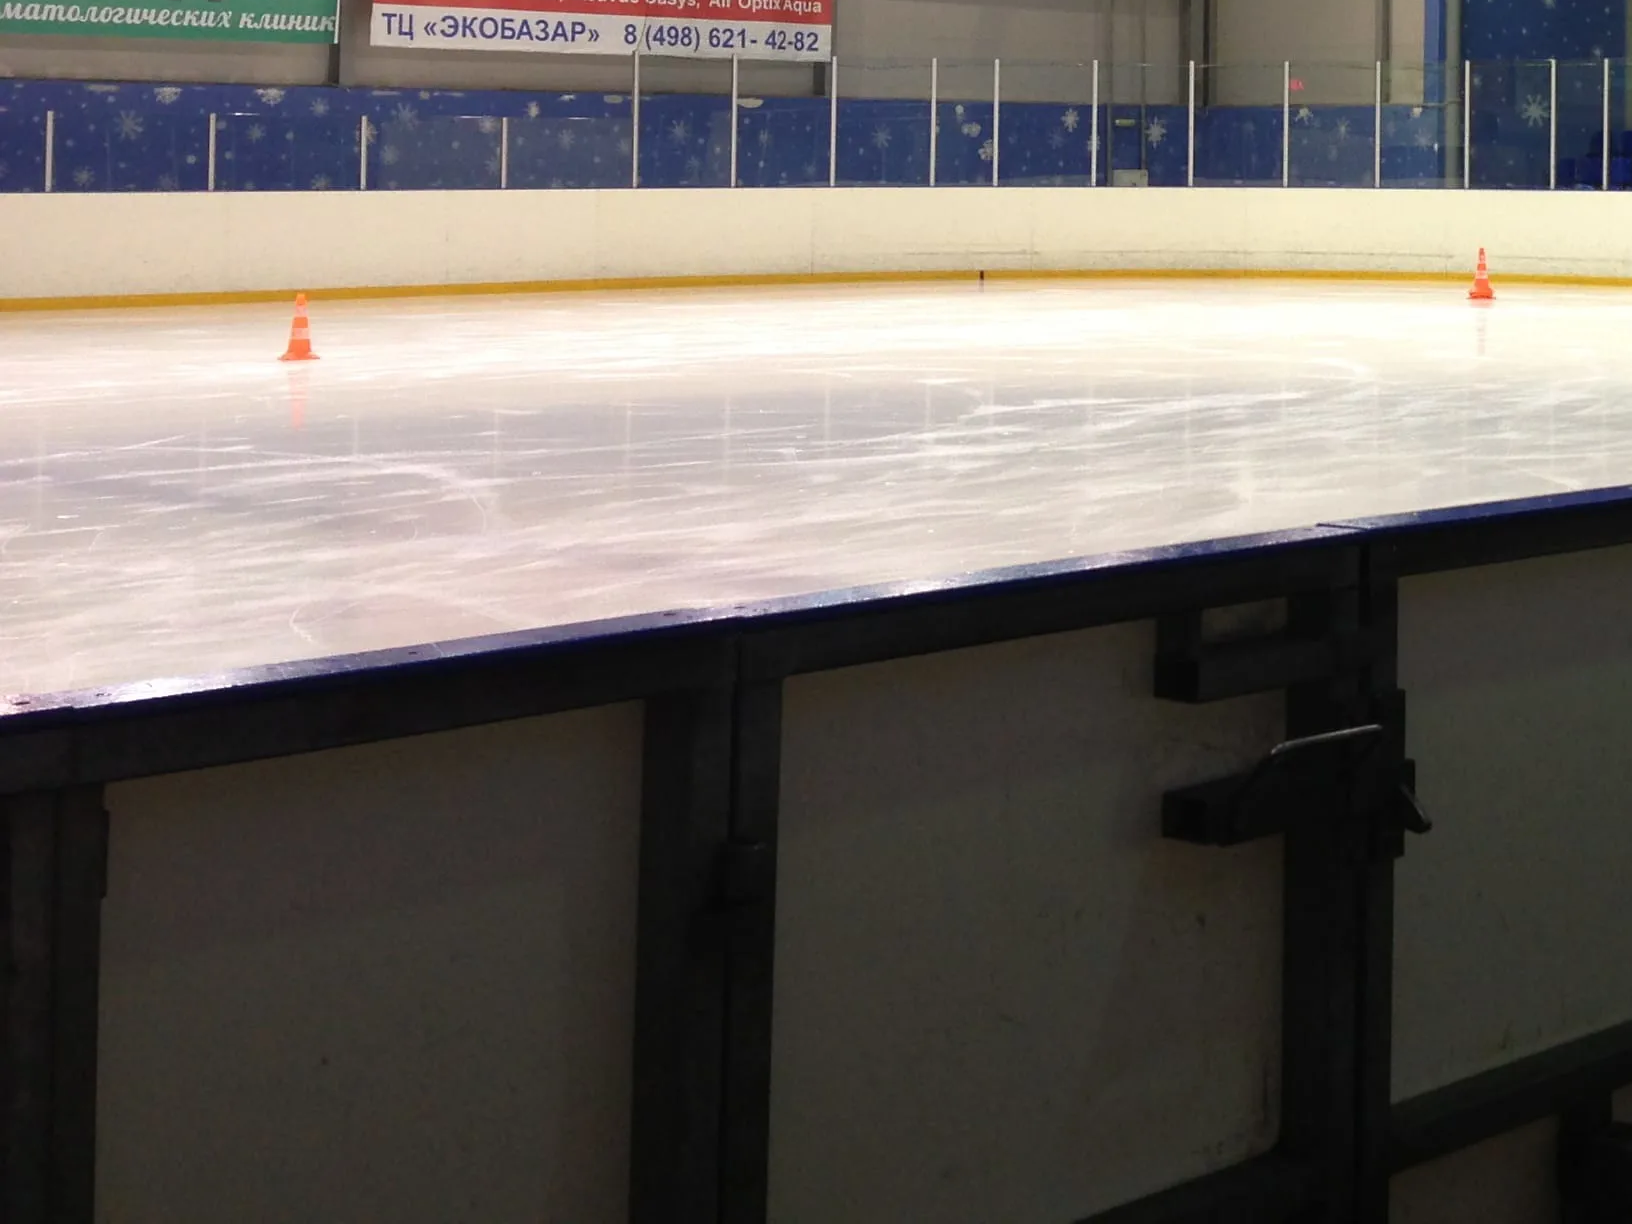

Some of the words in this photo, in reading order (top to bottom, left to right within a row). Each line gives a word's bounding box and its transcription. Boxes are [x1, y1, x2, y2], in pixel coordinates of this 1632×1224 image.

[238, 10, 337, 33] клиник
[381, 11, 415, 41] ТЦ
[422, 15, 601, 44] «ЭКОБАЗАР»
[623, 23, 638, 46] 8
[644, 23, 701, 53] (498)
[764, 28, 820, 52] 42-82
